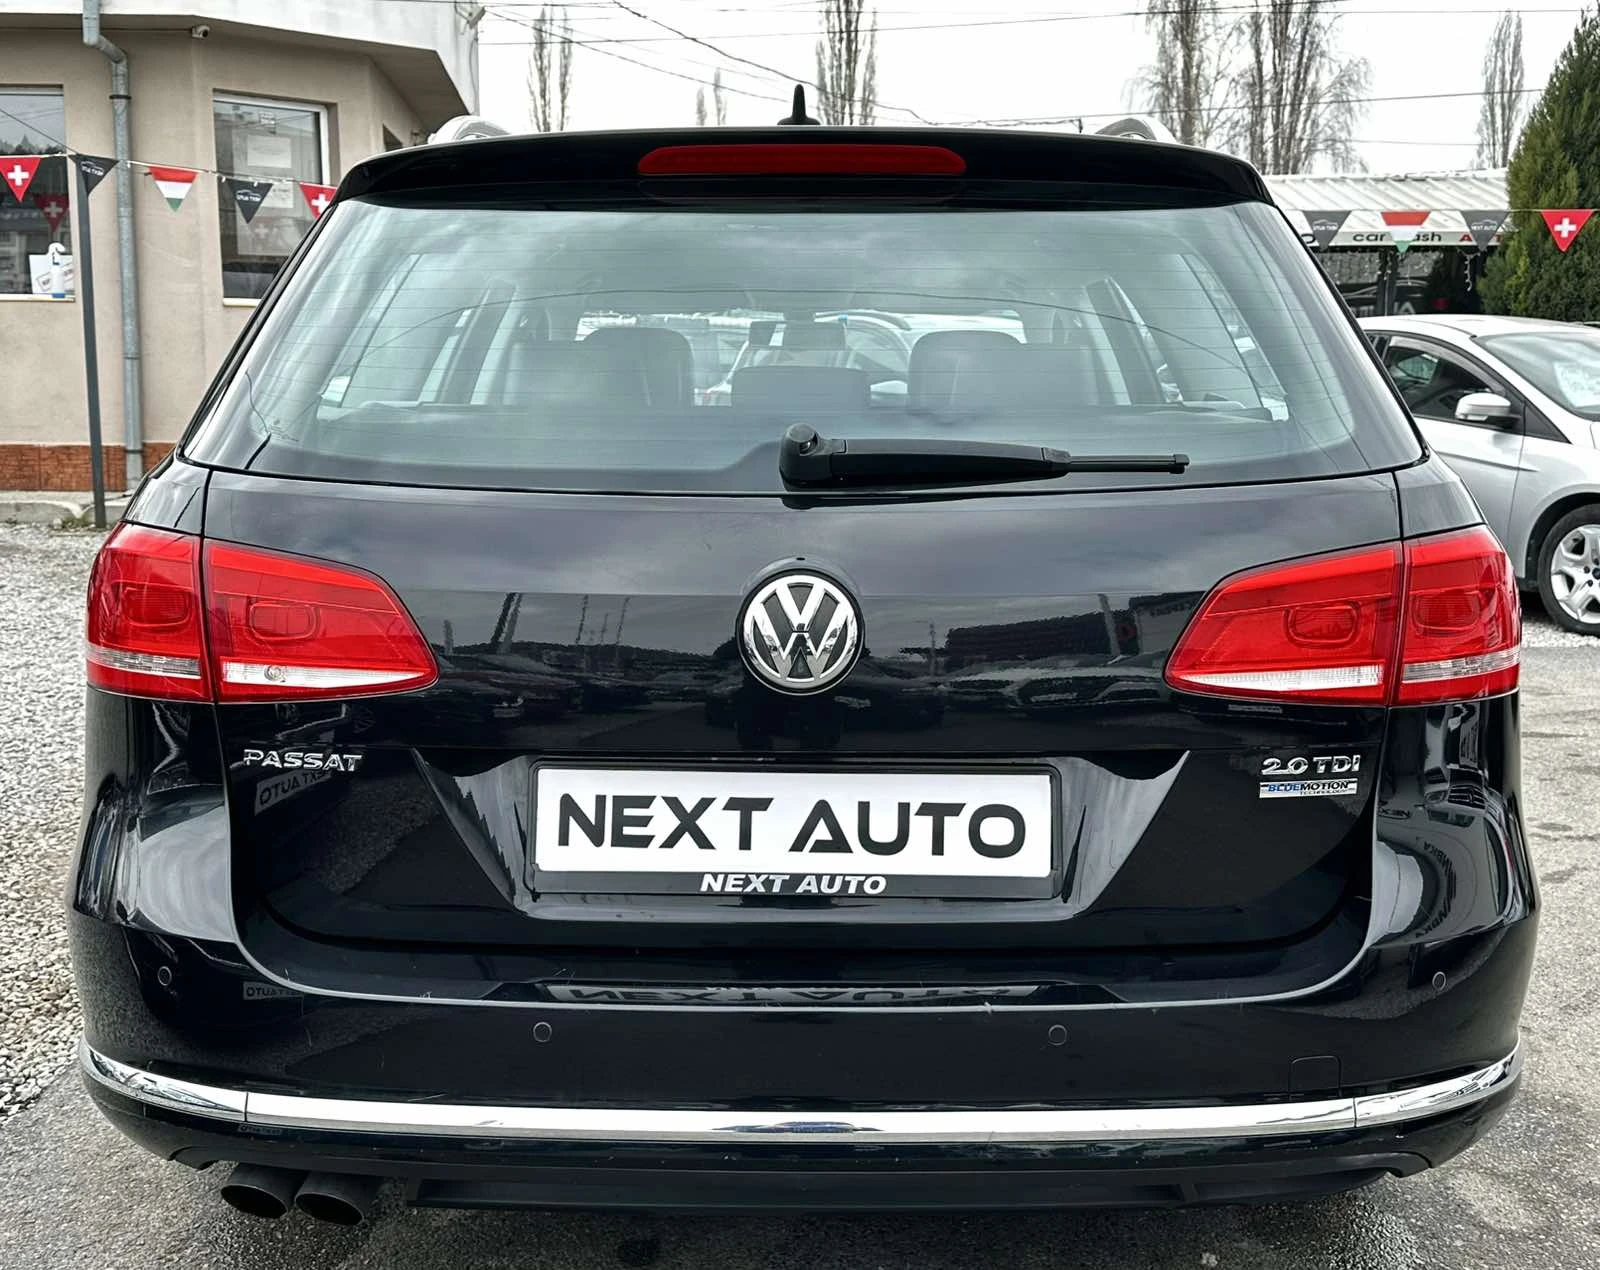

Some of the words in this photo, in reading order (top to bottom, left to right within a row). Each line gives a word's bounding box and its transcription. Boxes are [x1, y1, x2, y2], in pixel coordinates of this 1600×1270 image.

[1353, 232, 1385, 242] car
[243, 749, 362, 771] PASSAT
[1312, 754, 1361, 773] TDI
[1267, 780, 1349, 792] BLUEMOTION
[558, 793, 774, 850] NEXT
[789, 799, 1026, 859] AUTO
[700, 873, 790, 892] NEXT
[795, 874, 887, 895] AUTO
